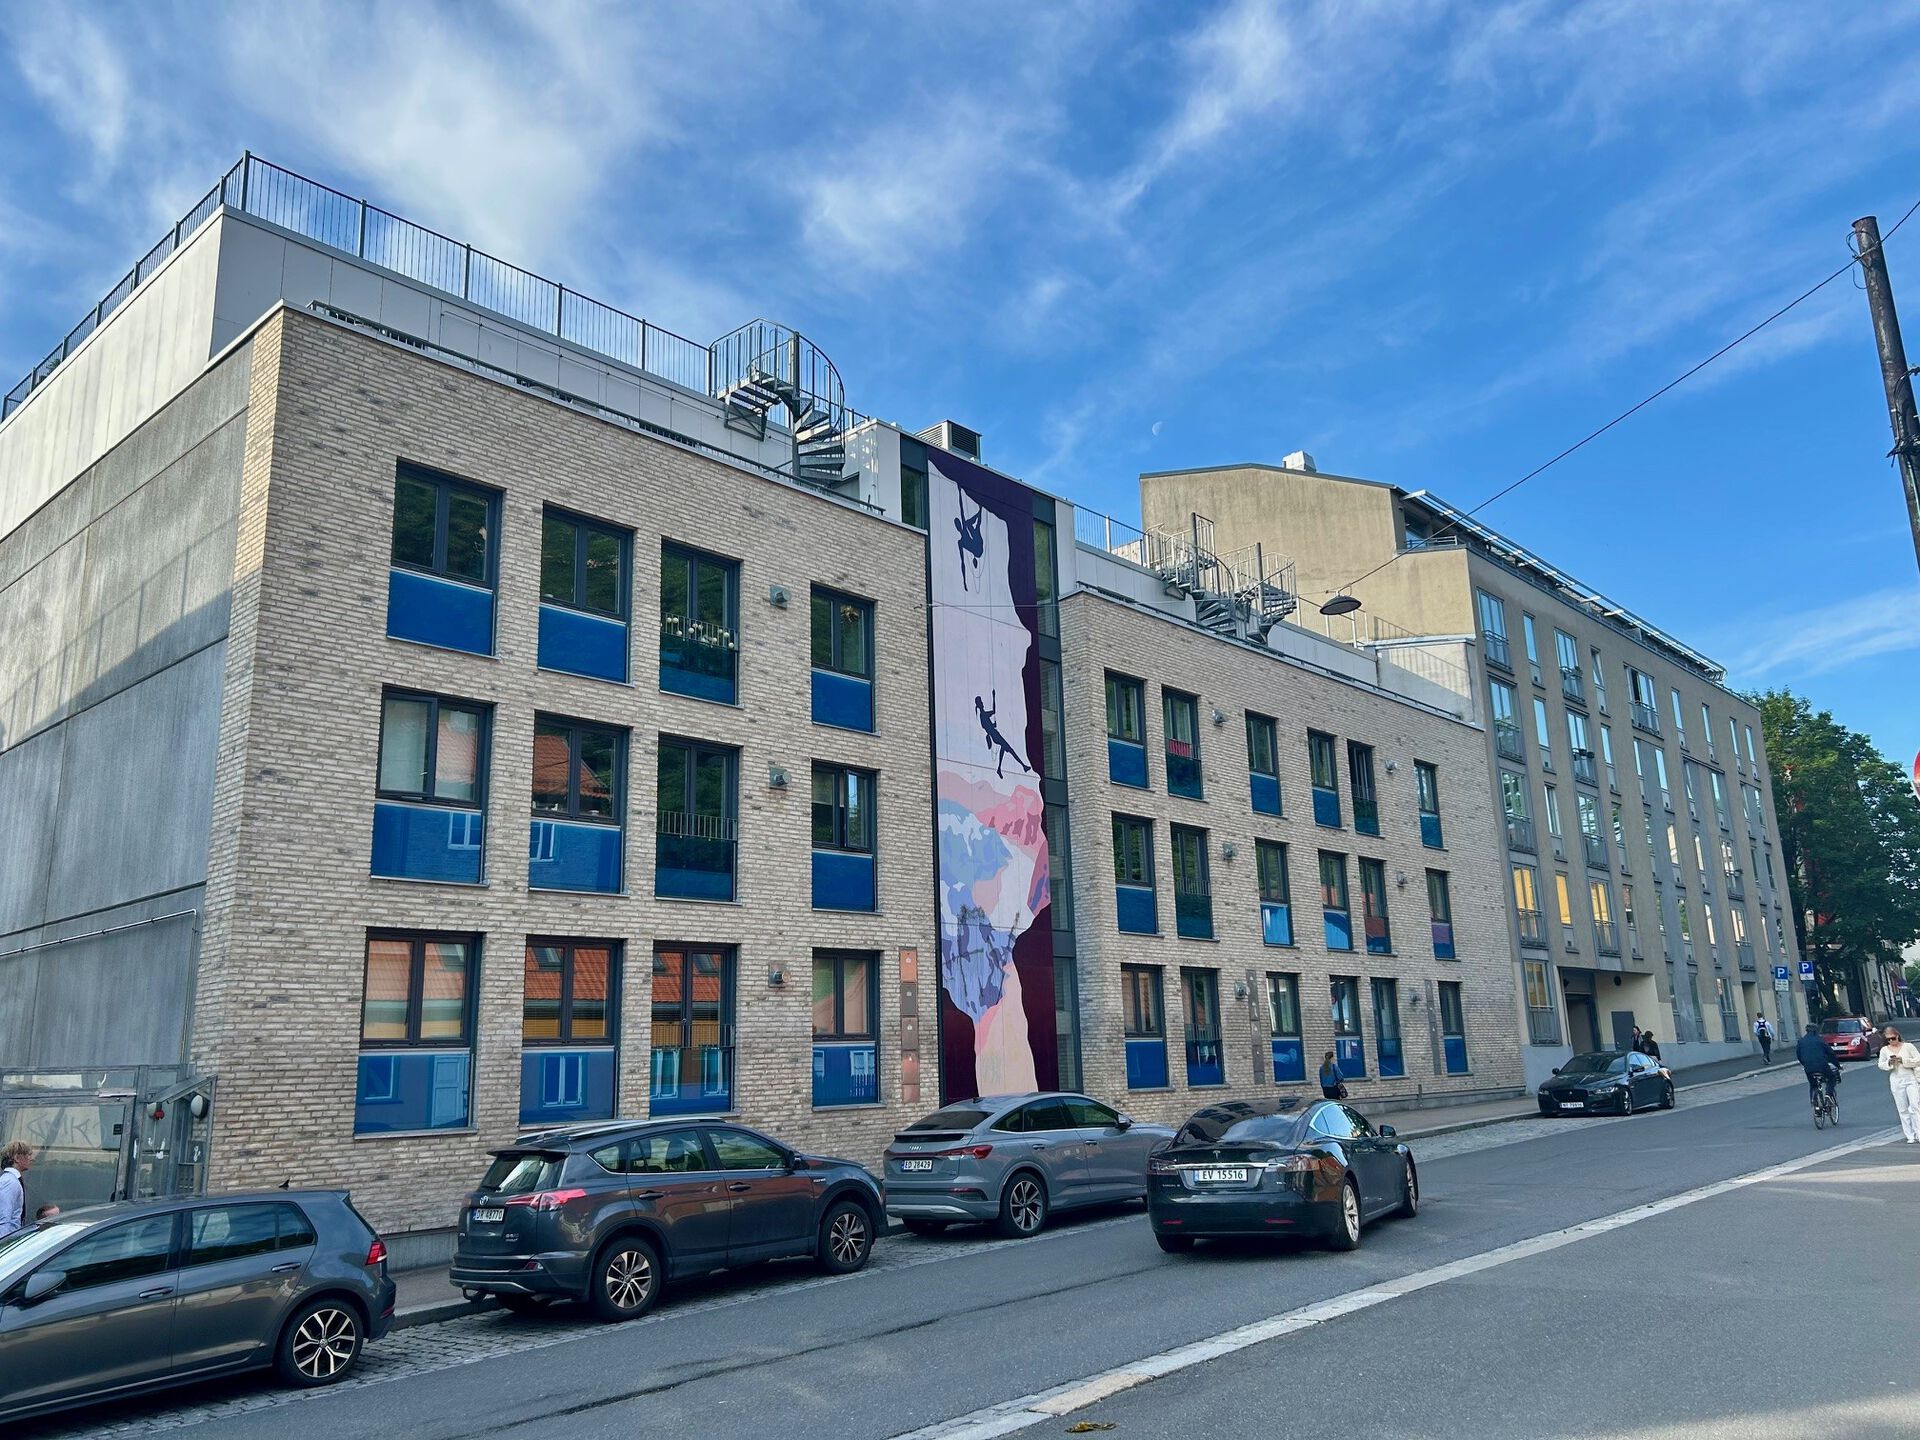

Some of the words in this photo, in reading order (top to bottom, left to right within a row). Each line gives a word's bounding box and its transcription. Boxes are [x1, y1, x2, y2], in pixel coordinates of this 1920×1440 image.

[1802, 963, 1809, 972] P
[1778, 968, 1785, 977] P
[1203, 1170, 1213, 1180] EV
[1218, 1170, 1243, 1179] 15516
